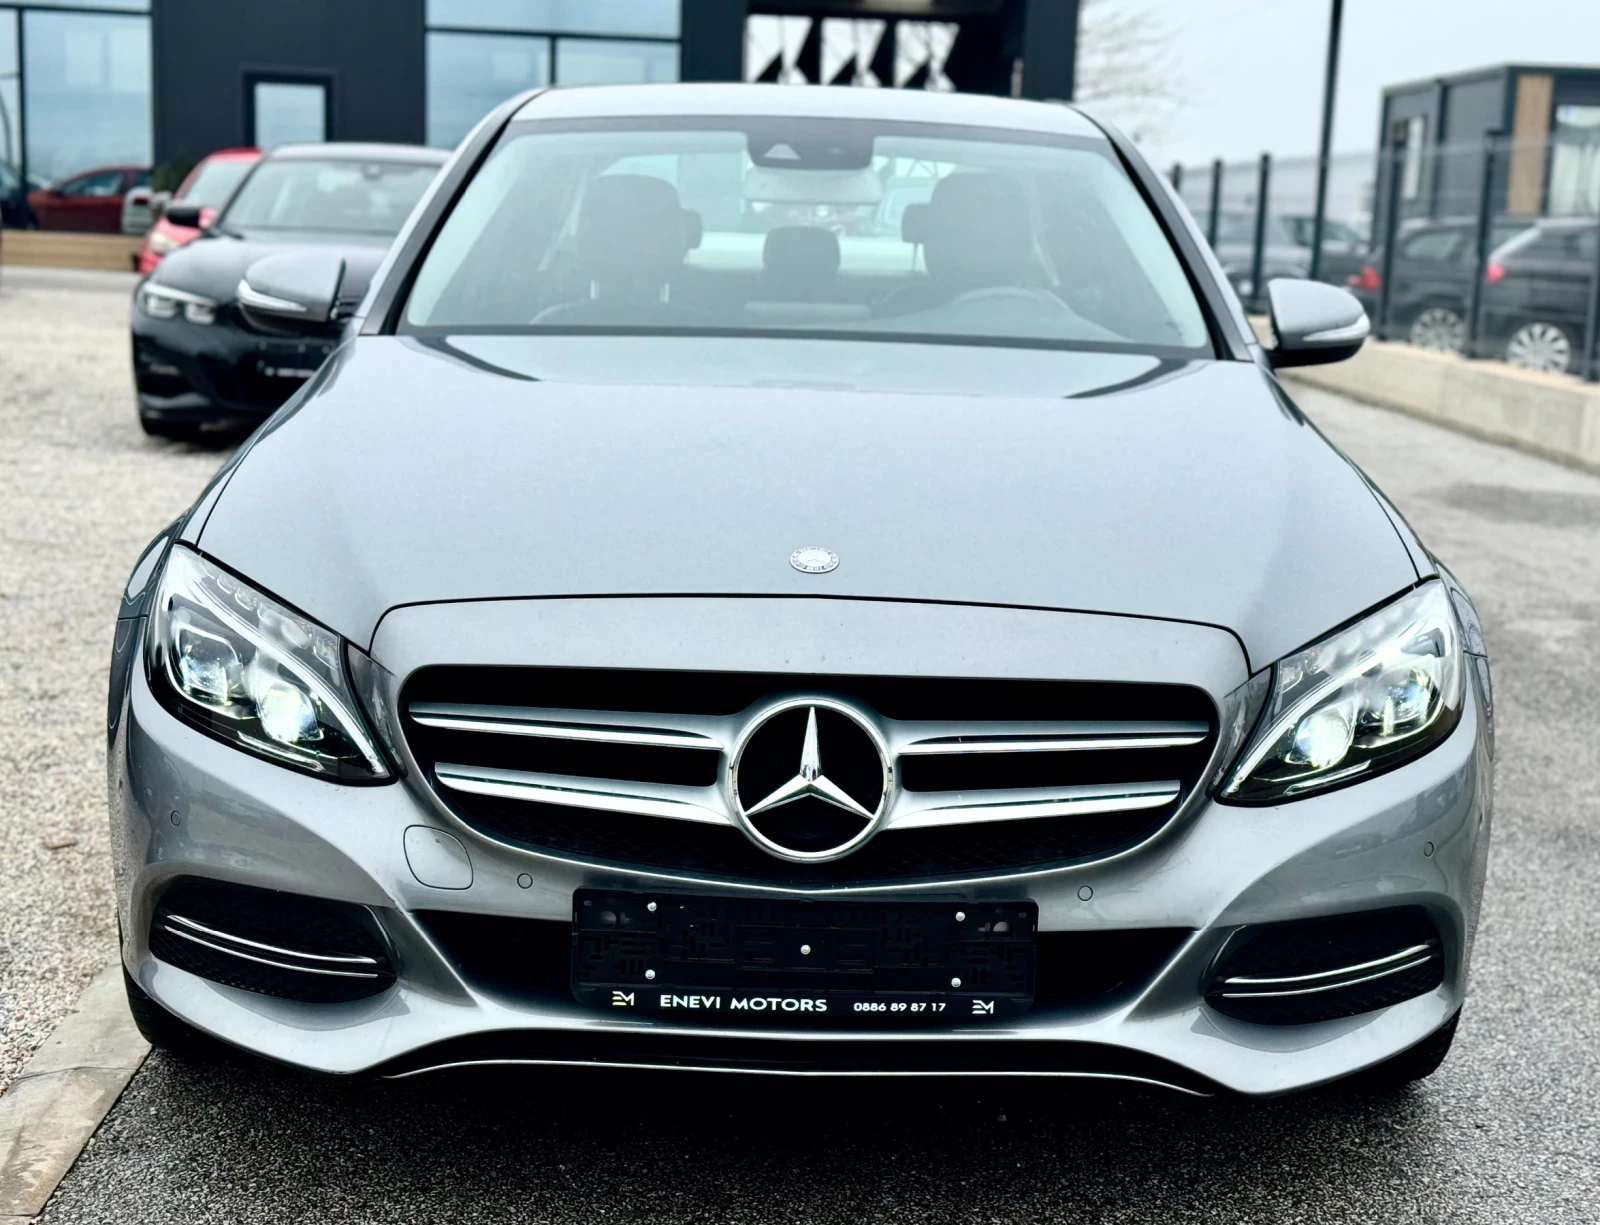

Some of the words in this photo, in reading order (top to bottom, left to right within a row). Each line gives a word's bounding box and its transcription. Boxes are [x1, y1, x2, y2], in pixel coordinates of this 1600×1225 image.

[660, 995, 720, 1008] ENEVI
[730, 998, 827, 1011] MOTORS
[854, 1003, 886, 1011] 0886
[890, 1003, 907, 1011] 89
[911, 1003, 926, 1011] 87
[932, 1003, 946, 1011] 17
